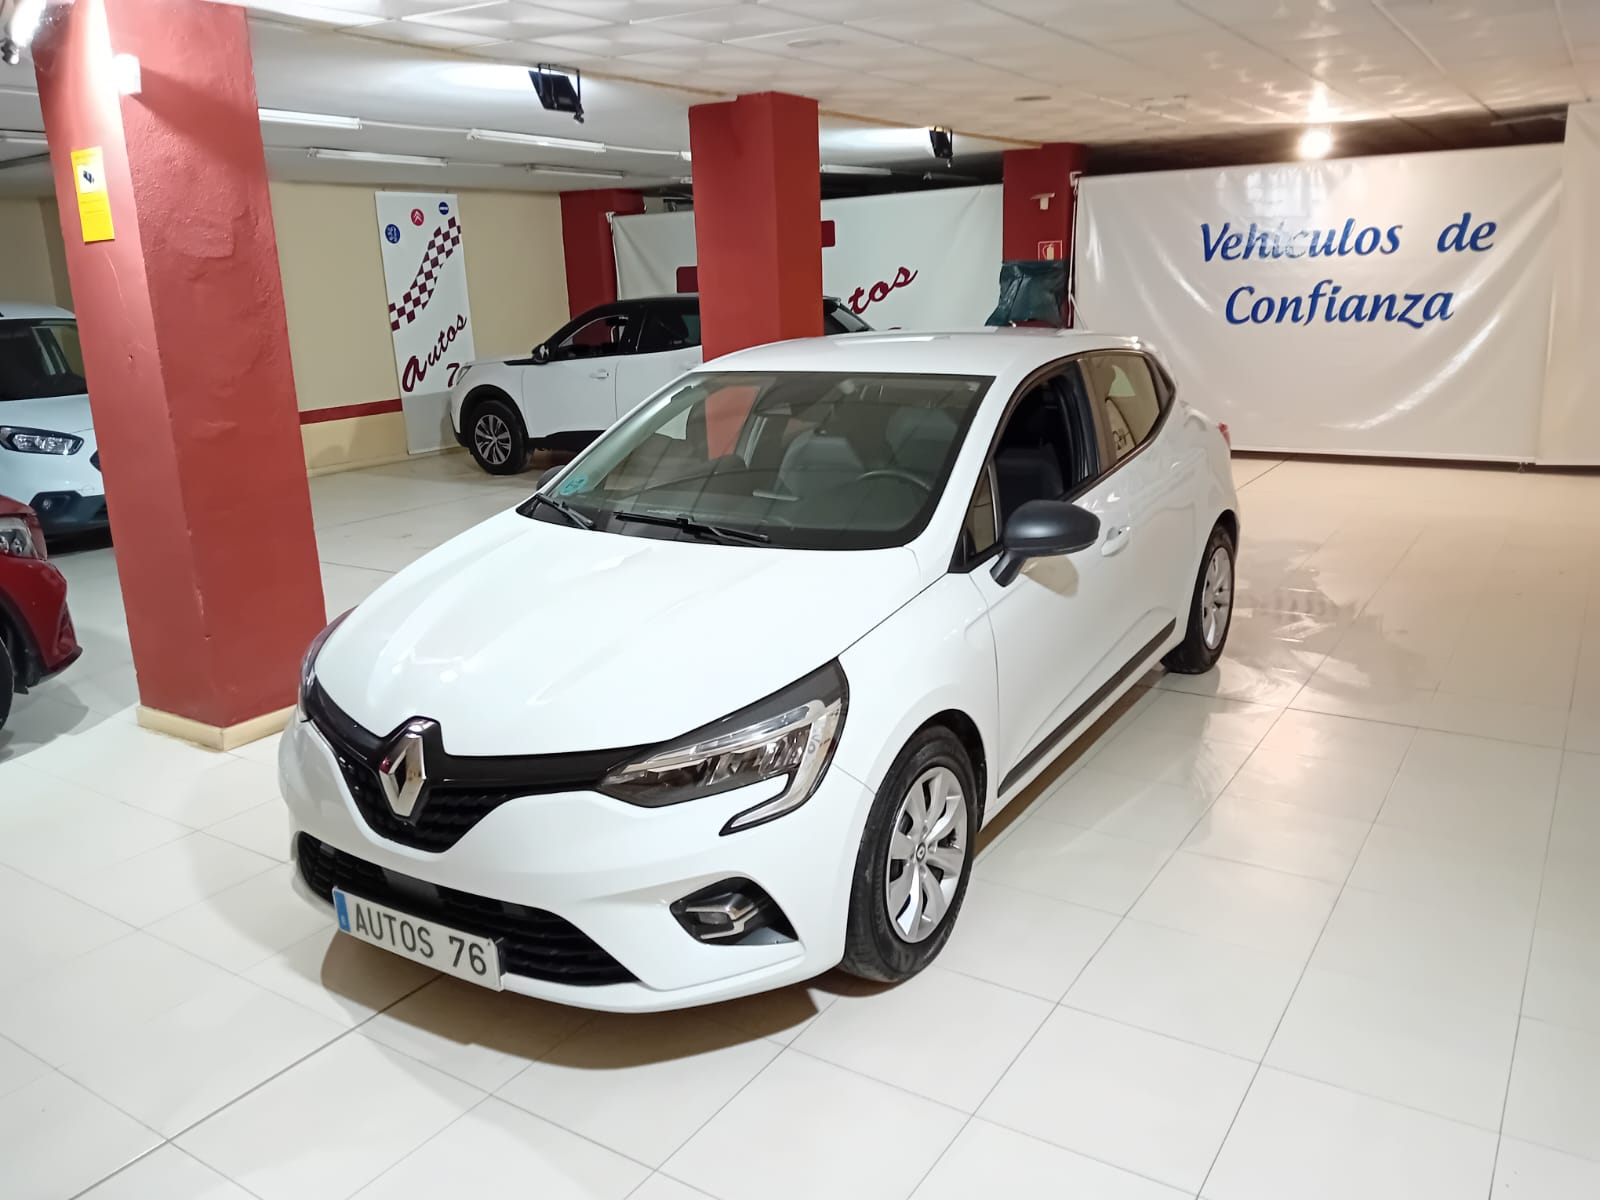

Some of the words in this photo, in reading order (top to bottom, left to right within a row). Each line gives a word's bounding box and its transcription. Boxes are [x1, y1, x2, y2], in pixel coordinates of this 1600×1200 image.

[1437, 212, 1497, 253] de
[848, 266, 918, 315] tos
[1225, 279, 1454, 327] Confianza
[446, 362, 460, 388] 7
[356, 903, 434, 959] AUTOS
[449, 935, 487, 976] 76
